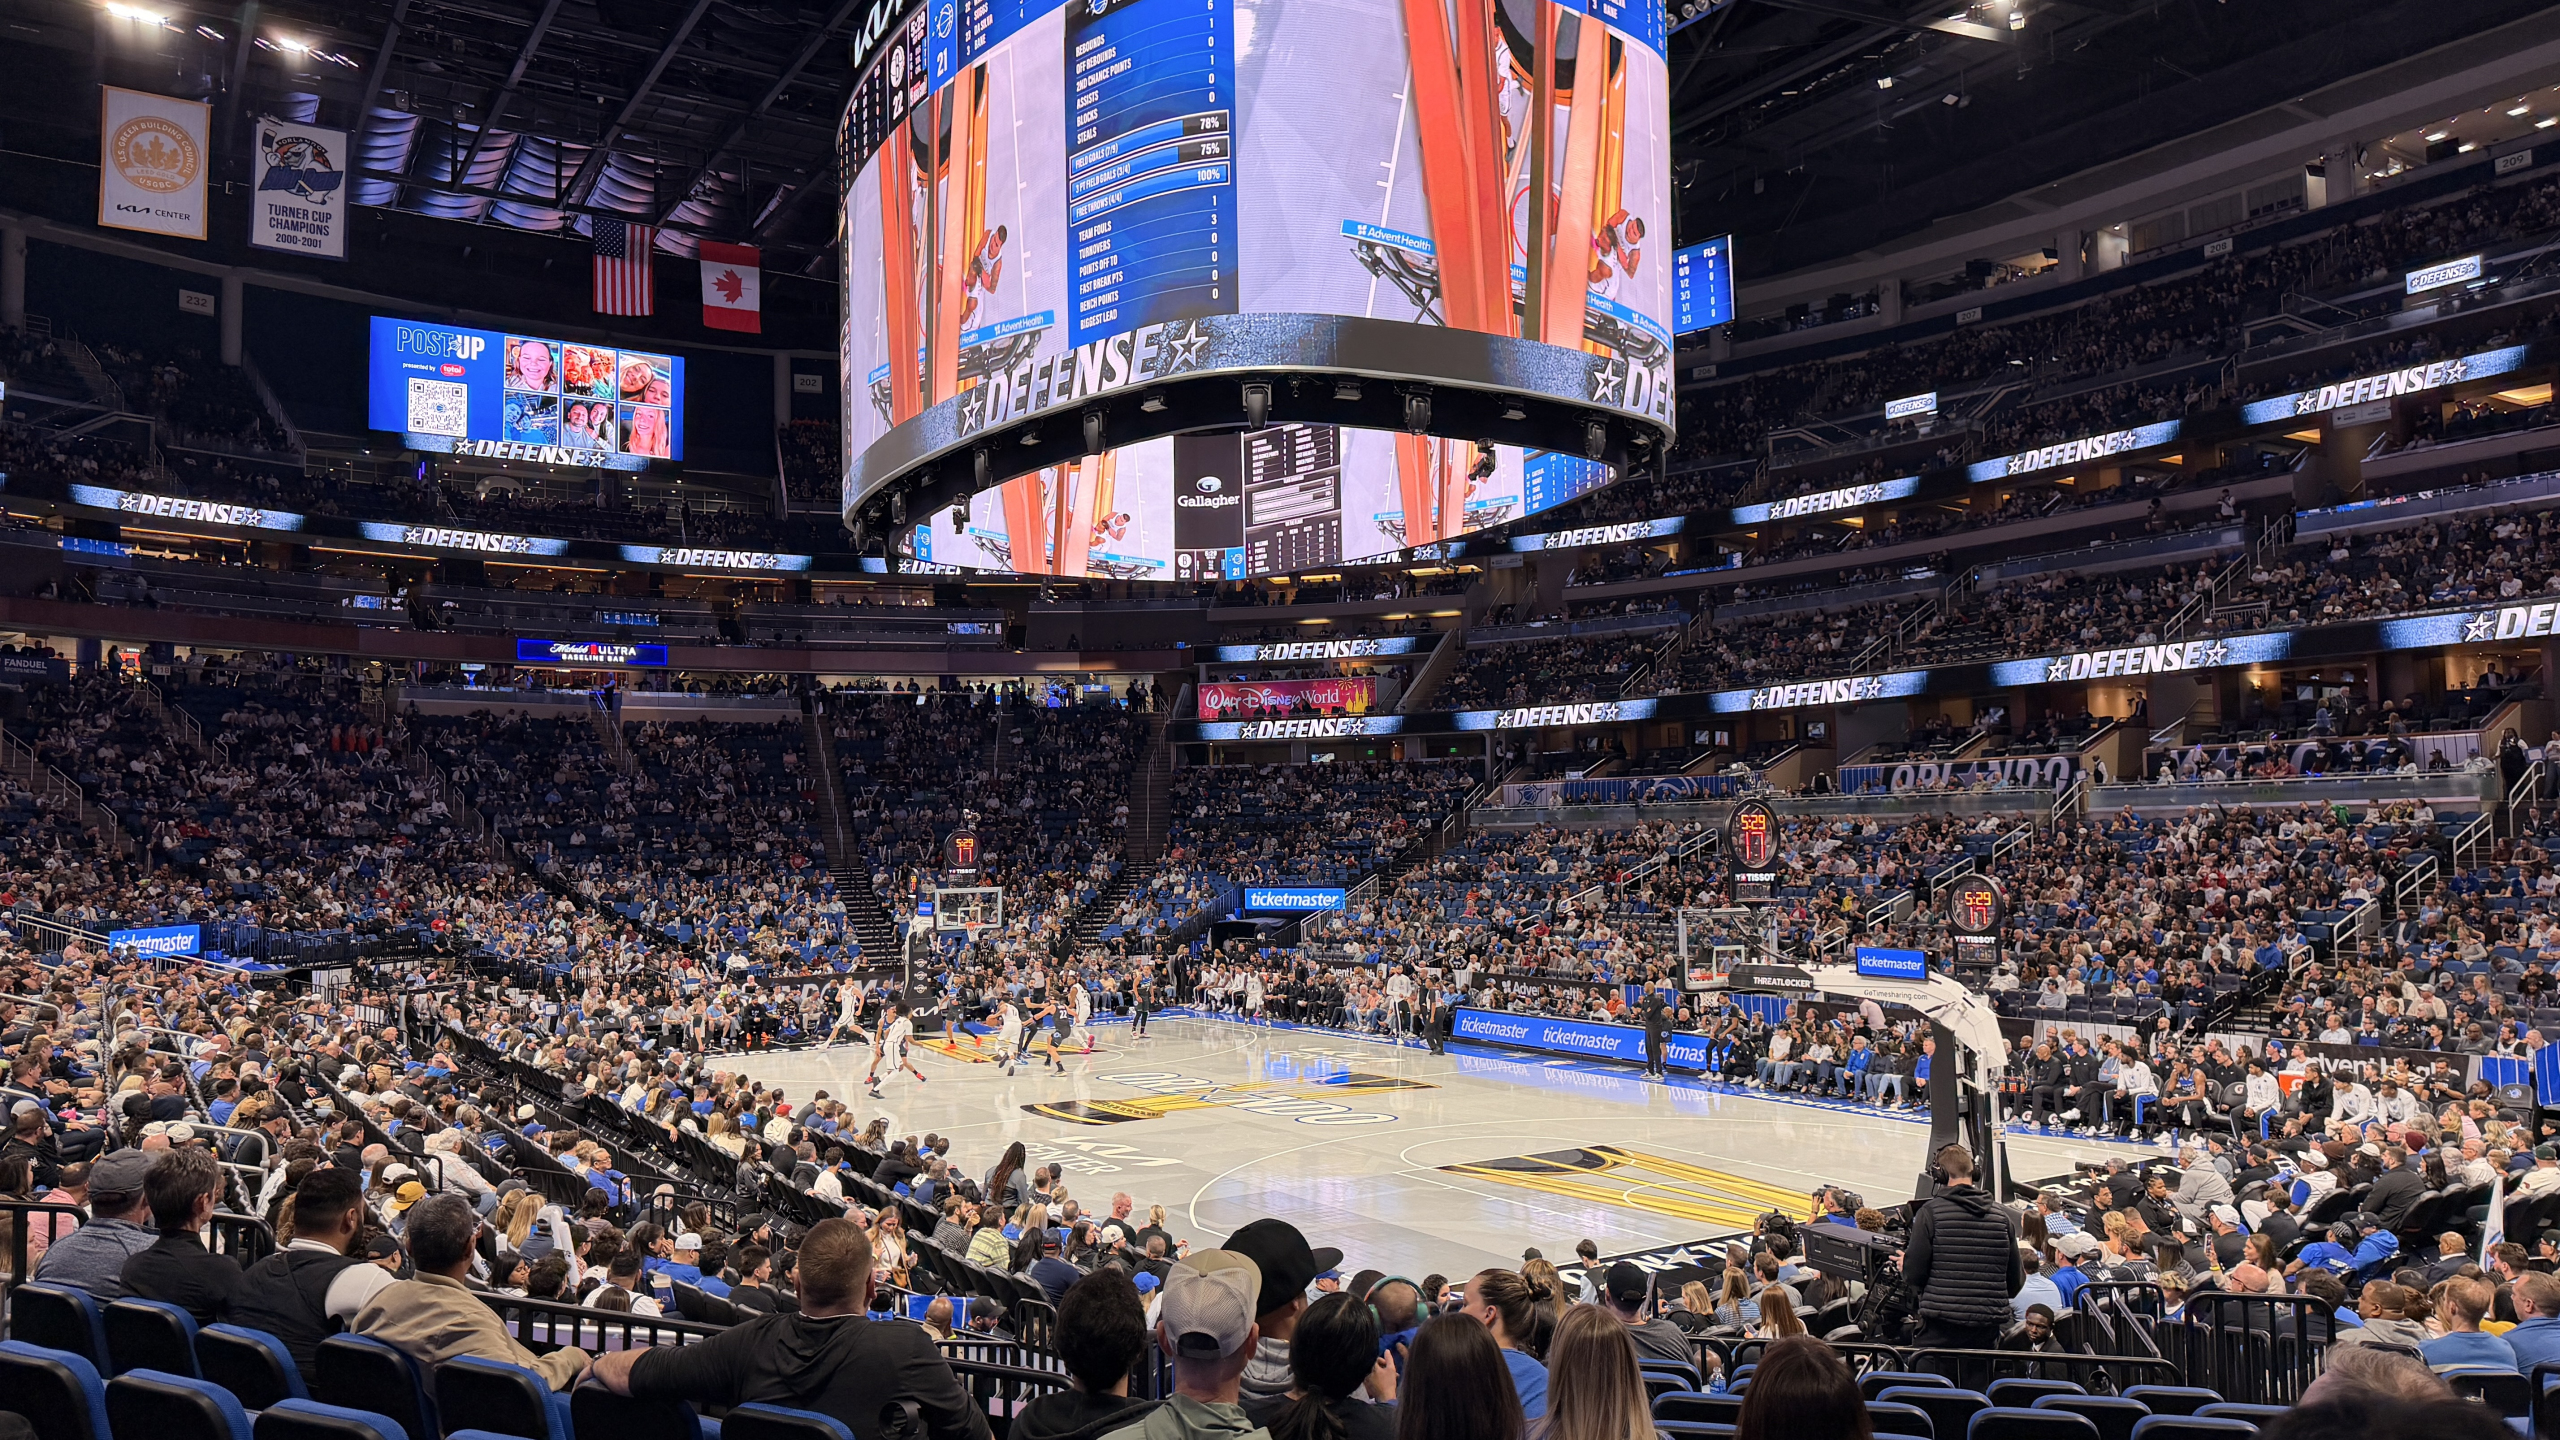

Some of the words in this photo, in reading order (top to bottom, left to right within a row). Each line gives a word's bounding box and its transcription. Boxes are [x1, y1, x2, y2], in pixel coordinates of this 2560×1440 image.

[1207, 0, 1213, 10] 6
[911, 10, 926, 38] 5:29
[1209, 18, 1214, 28] 1
[1076, 34, 1105, 58] REBOUNDS
[1208, 36, 1214, 47] 0
[937, 47, 947, 78] 21
[1076, 62, 1086, 74] OFF
[1086, 47, 1116, 71] REBOUNDS
[1210, 55, 1214, 65] 1
[1076, 78, 1087, 92] 2ND
[1088, 68, 1109, 88] CHANCE
[1110, 58, 1132, 78] POINTS
[1208, 73, 1215, 84] 0
[893, 90, 904, 120] 22
[1076, 90, 1098, 110] ASSISTS
[1209, 92, 1215, 103] 0
[1077, 109, 1098, 127] BLOCKS
[1200, 117, 1219, 130] 78%
[1077, 127, 1097, 145] STEALS
[118, 125, 139, 148] GREEN
[140, 121, 183, 141] BUILDING
[180, 140, 195, 175] COUNCIL
[1200, 143, 1220, 155] 75%
[1076, 155, 1088, 169] FIELD
[1089, 149, 1104, 163] GOALS
[2502, 155, 2524, 169] 209
[139, 177, 172, 189] USGBC
[1086, 176, 1099, 189] FIELD
[1100, 169, 1116, 183] GOALS
[1197, 168, 1220, 182] 100%
[1076, 206, 1088, 218] FREE
[1088, 197, 1108, 213] THROWS
[1212, 195, 1217, 206] 1
[155, 209, 190, 221] CENTER
[268, 204, 309, 221] TURNER
[312, 210, 332, 224] CUP
[1211, 214, 1217, 225] 3
[269, 217, 330, 237] CHAMPIONS
[1079, 227, 1093, 242] TEAM
[1094, 221, 1112, 236] FOULS
[275, 233, 322, 249] 2000-2001
[1211, 232, 1218, 243] 0
[1366, 224, 1432, 253] AdventHealth
[1079, 239, 1111, 260] TURNOVERS
[1212, 251, 1218, 262] 0
[1678, 254, 1689, 265] FG
[1703, 247, 1716, 258] FLS
[2209, 242, 2228, 254] 208
[1080, 262, 1099, 277] POINTS
[1099, 256, 1110, 270] OFF
[1110, 255, 1118, 266] TO
[1212, 269, 1218, 280] 0
[2420, 262, 2466, 286] DEFENSE
[1080, 281, 1093, 295] FAST
[1093, 275, 1111, 291] BREAK
[1112, 271, 1123, 285] PTS
[1680, 279, 1689, 288] 1/2
[186, 295, 207, 308] 232
[1080, 298, 1097, 312] BENCH
[1098, 291, 1119, 306] POINTS
[1212, 288, 1218, 299] 0
[1680, 291, 1690, 300] 3/3
[1080, 314, 1103, 330] BIGGEST
[1103, 309, 1118, 323] LEAD
[1682, 315, 1692, 324] 2/3
[396, 326, 452, 358] POST
[459, 335, 485, 360] UP
[402, 361, 427, 372] presented
[428, 364, 436, 373] by
[800, 378, 817, 387] 202
[984, 322, 1164, 430] DEFENSE
[2316, 362, 2446, 413] DEFENSE
[1892, 402, 1932, 418] DEFENSE
[474, 440, 588, 466] DEFENSE
[2022, 432, 2118, 472] DEFENSE
[137, 494, 245, 525] DEFENSE
[1177, 495, 1240, 509] Gallagher
[1784, 486, 1869, 517] DEFENSE
[422, 527, 514, 553] DEFENSE
[1558, 522, 1638, 549] DEFENSE
[676, 548, 764, 570] DEFENSE
[921, 547, 927, 557] 21
[1180, 570, 1190, 578] 22
[1233, 567, 1240, 576] 21
[550, 643, 589, 654] Michelob
[598, 646, 636, 656] ULTRA
[562, 654, 604, 662] BASELINE
[1273, 640, 1364, 660] DEFENSE
[4, 658, 48, 669] FANDUEL
[2068, 640, 2204, 682] DEFENSE
[1300, 688, 1340, 705] World
[1766, 677, 1865, 708] DEFENSE
[1512, 702, 1603, 728] DEFENSE
[1257, 718, 1350, 739] DEFENSE
[1740, 814, 1766, 830] 5:29
[956, 838, 974, 847] 5:29
[1744, 831, 1764, 860] 17
[959, 848, 972, 864] 17
[1746, 874, 1775, 882] TISSOT
[1250, 890, 1339, 908] ticketmaster
[1964, 891, 1992, 906] 5:29
[1969, 906, 1988, 925] 17
[1966, 936, 1996, 944] TISSOT
[1861, 956, 1922, 971] ticketmaster
[1753, 976, 1812, 988] THREATLOCKER
[1864, 989, 1928, 1002] GoTimesharing.com
[1060, 1010, 1068, 1019] 22
[1460, 1016, 1529, 1039] ticketmaster
[1543, 1026, 1622, 1052] ticketmaster
[1049, 1136, 1184, 1166] KIA
